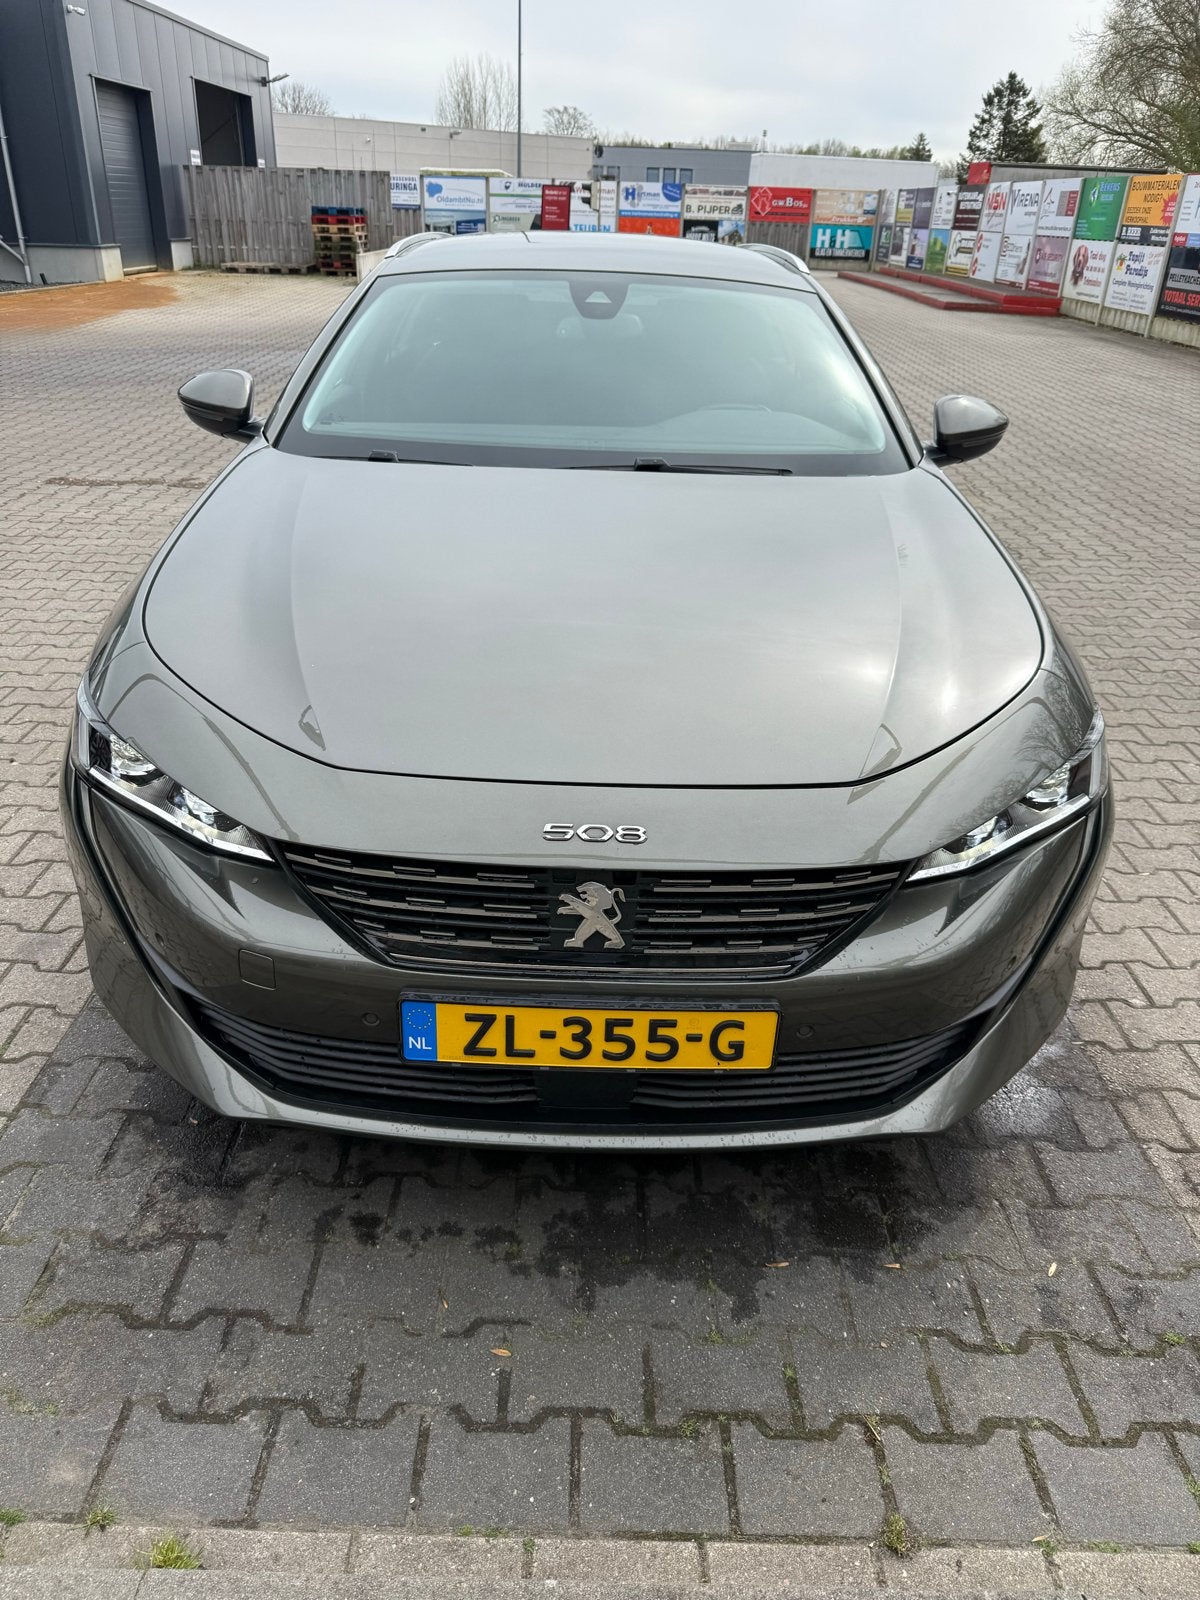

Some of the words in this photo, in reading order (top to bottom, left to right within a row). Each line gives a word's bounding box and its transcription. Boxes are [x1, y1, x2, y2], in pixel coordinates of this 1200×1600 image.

[390, 182, 418, 192] URINGA
[697, 204, 731, 215] PIJPER
[1164, 290, 1186, 304] TOTAAL
[542, 823, 648, 844] 508
[408, 1036, 432, 1050] NL
[463, 1013, 745, 1062] ZL-355-G
